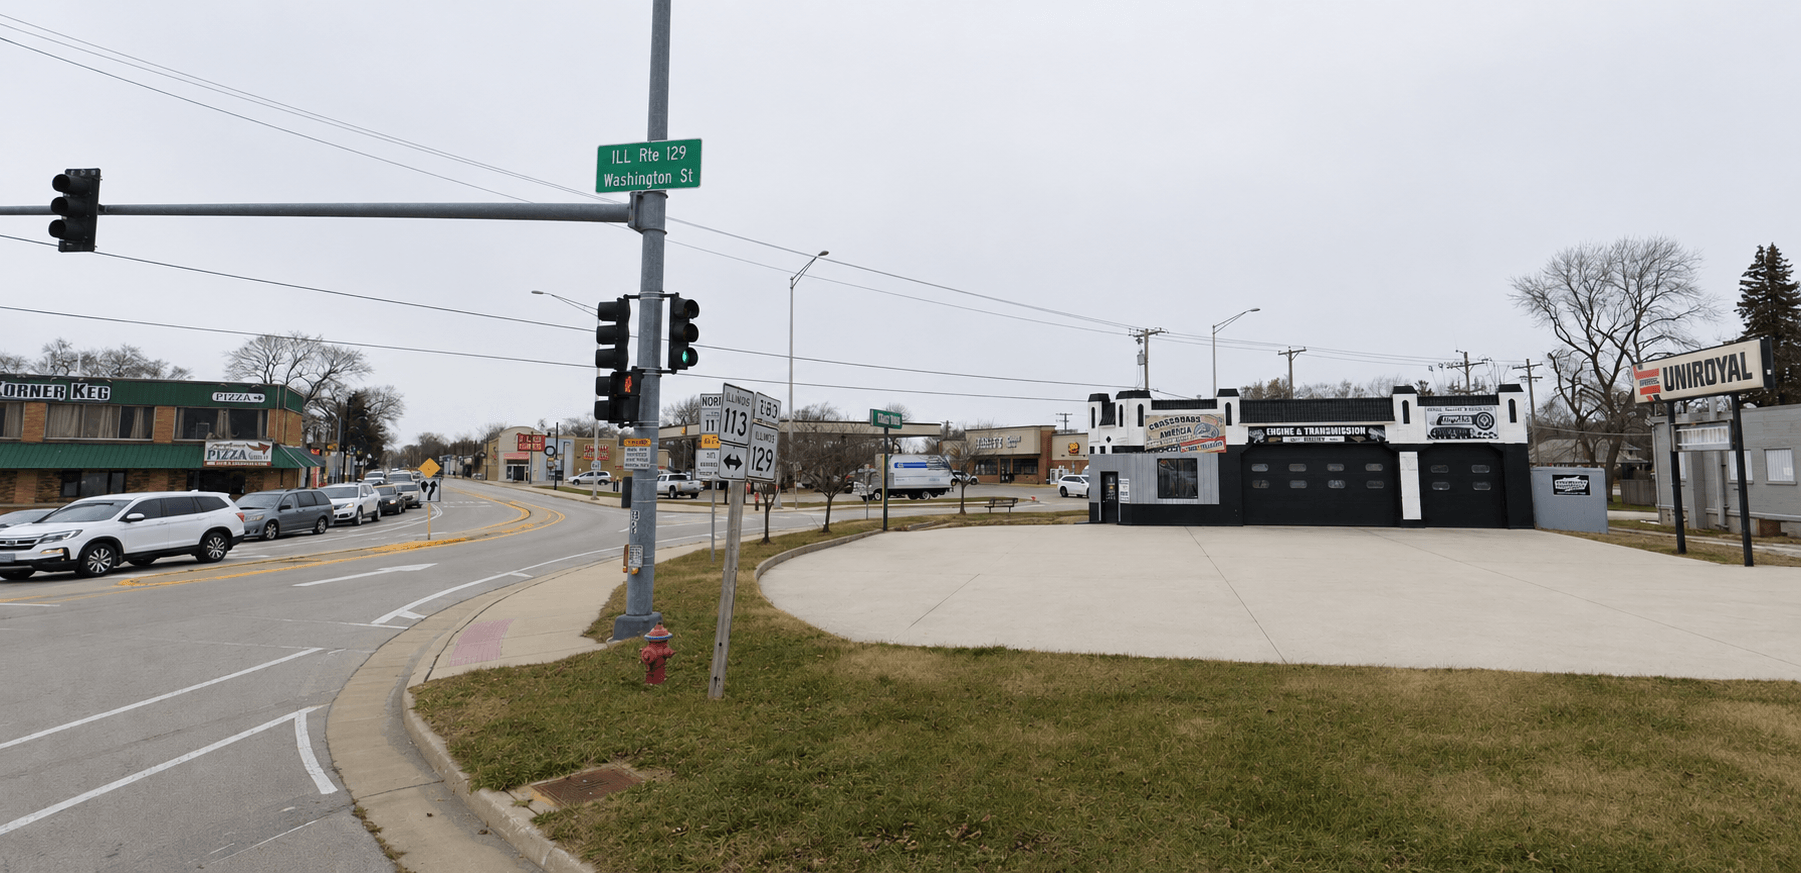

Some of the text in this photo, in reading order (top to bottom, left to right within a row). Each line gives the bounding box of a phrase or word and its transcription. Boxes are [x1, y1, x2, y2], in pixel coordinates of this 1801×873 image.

[612, 145, 687, 164] ILL Rte 129
[604, 168, 693, 189] Washington St
[1662, 351, 1753, 392] UNIROYAL
[0, 381, 65, 399] ORNER
[216, 393, 251, 401] PIZZA
[724, 407, 748, 437] 113
[207, 449, 247, 460] PIZZA
[751, 445, 773, 472] 129
